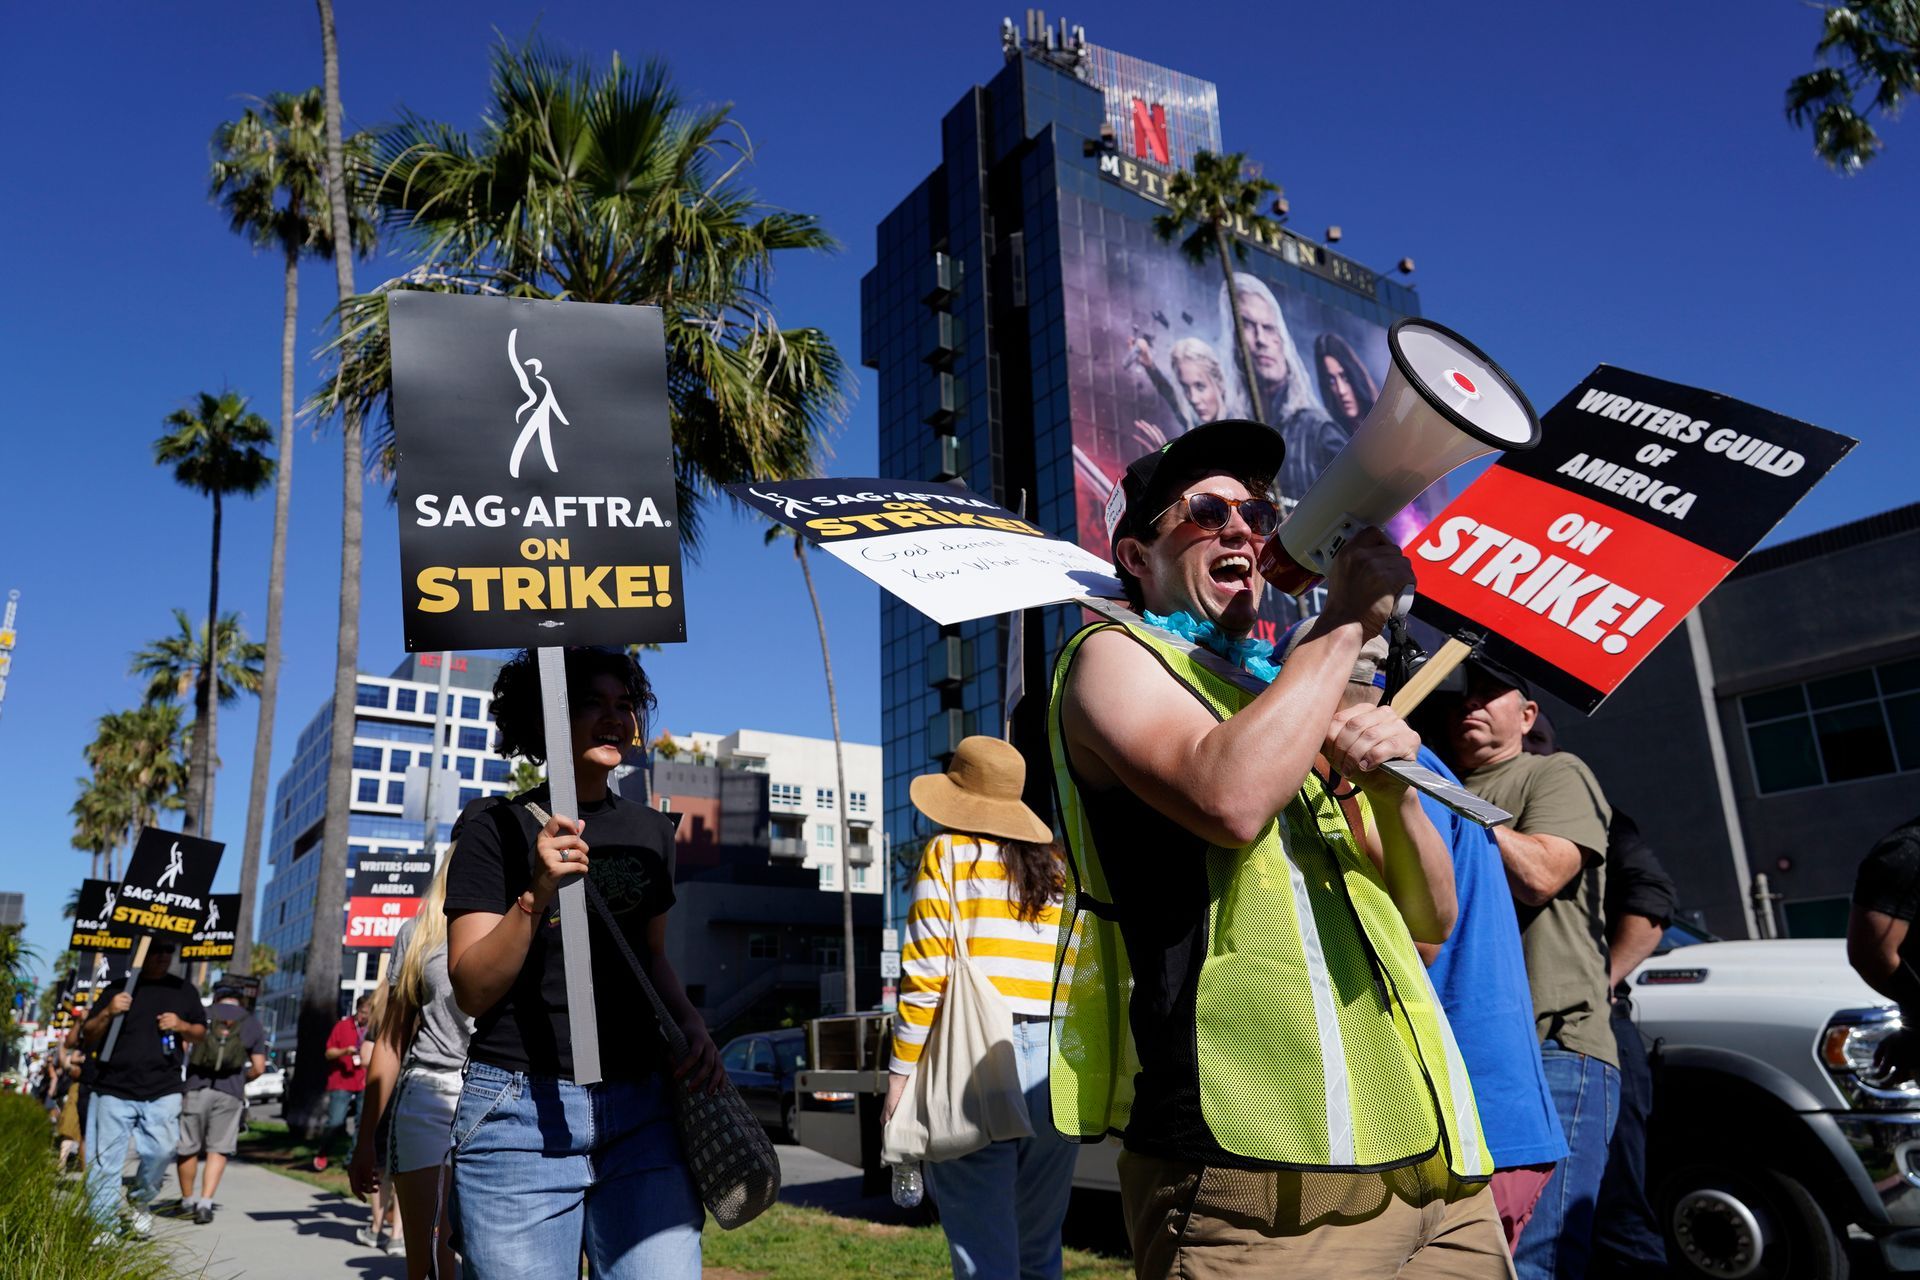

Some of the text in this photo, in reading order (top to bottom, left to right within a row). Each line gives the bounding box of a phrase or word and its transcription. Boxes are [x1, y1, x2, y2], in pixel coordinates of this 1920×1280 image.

[1132, 97, 1169, 164] N
[1576, 388, 1805, 477] WRITERS GUILD
[1635, 443, 1678, 467] OF
[1556, 453, 1697, 520] AMERICA
[882, 502, 933, 511] ON
[806, 511, 1045, 536] STRIKE!
[1547, 513, 1614, 556] ON
[519, 538, 570, 561] ON
[861, 543, 928, 562] God
[901, 566, 960, 584] Know
[1417, 515, 1665, 655] STRIKE!
[416, 565, 673, 613] STRIKE!
[360, 860, 431, 873] WRITERS GUILD
[388, 873, 400, 883] OF
[370, 883, 415, 895] AMERICA
[150, 903, 168, 914] ON
[381, 902, 401, 915] ON
[113, 906, 197, 934] STRIKE!
[72, 933, 132, 949] STRIKE!
[181, 945, 233, 957] STRIKE!
